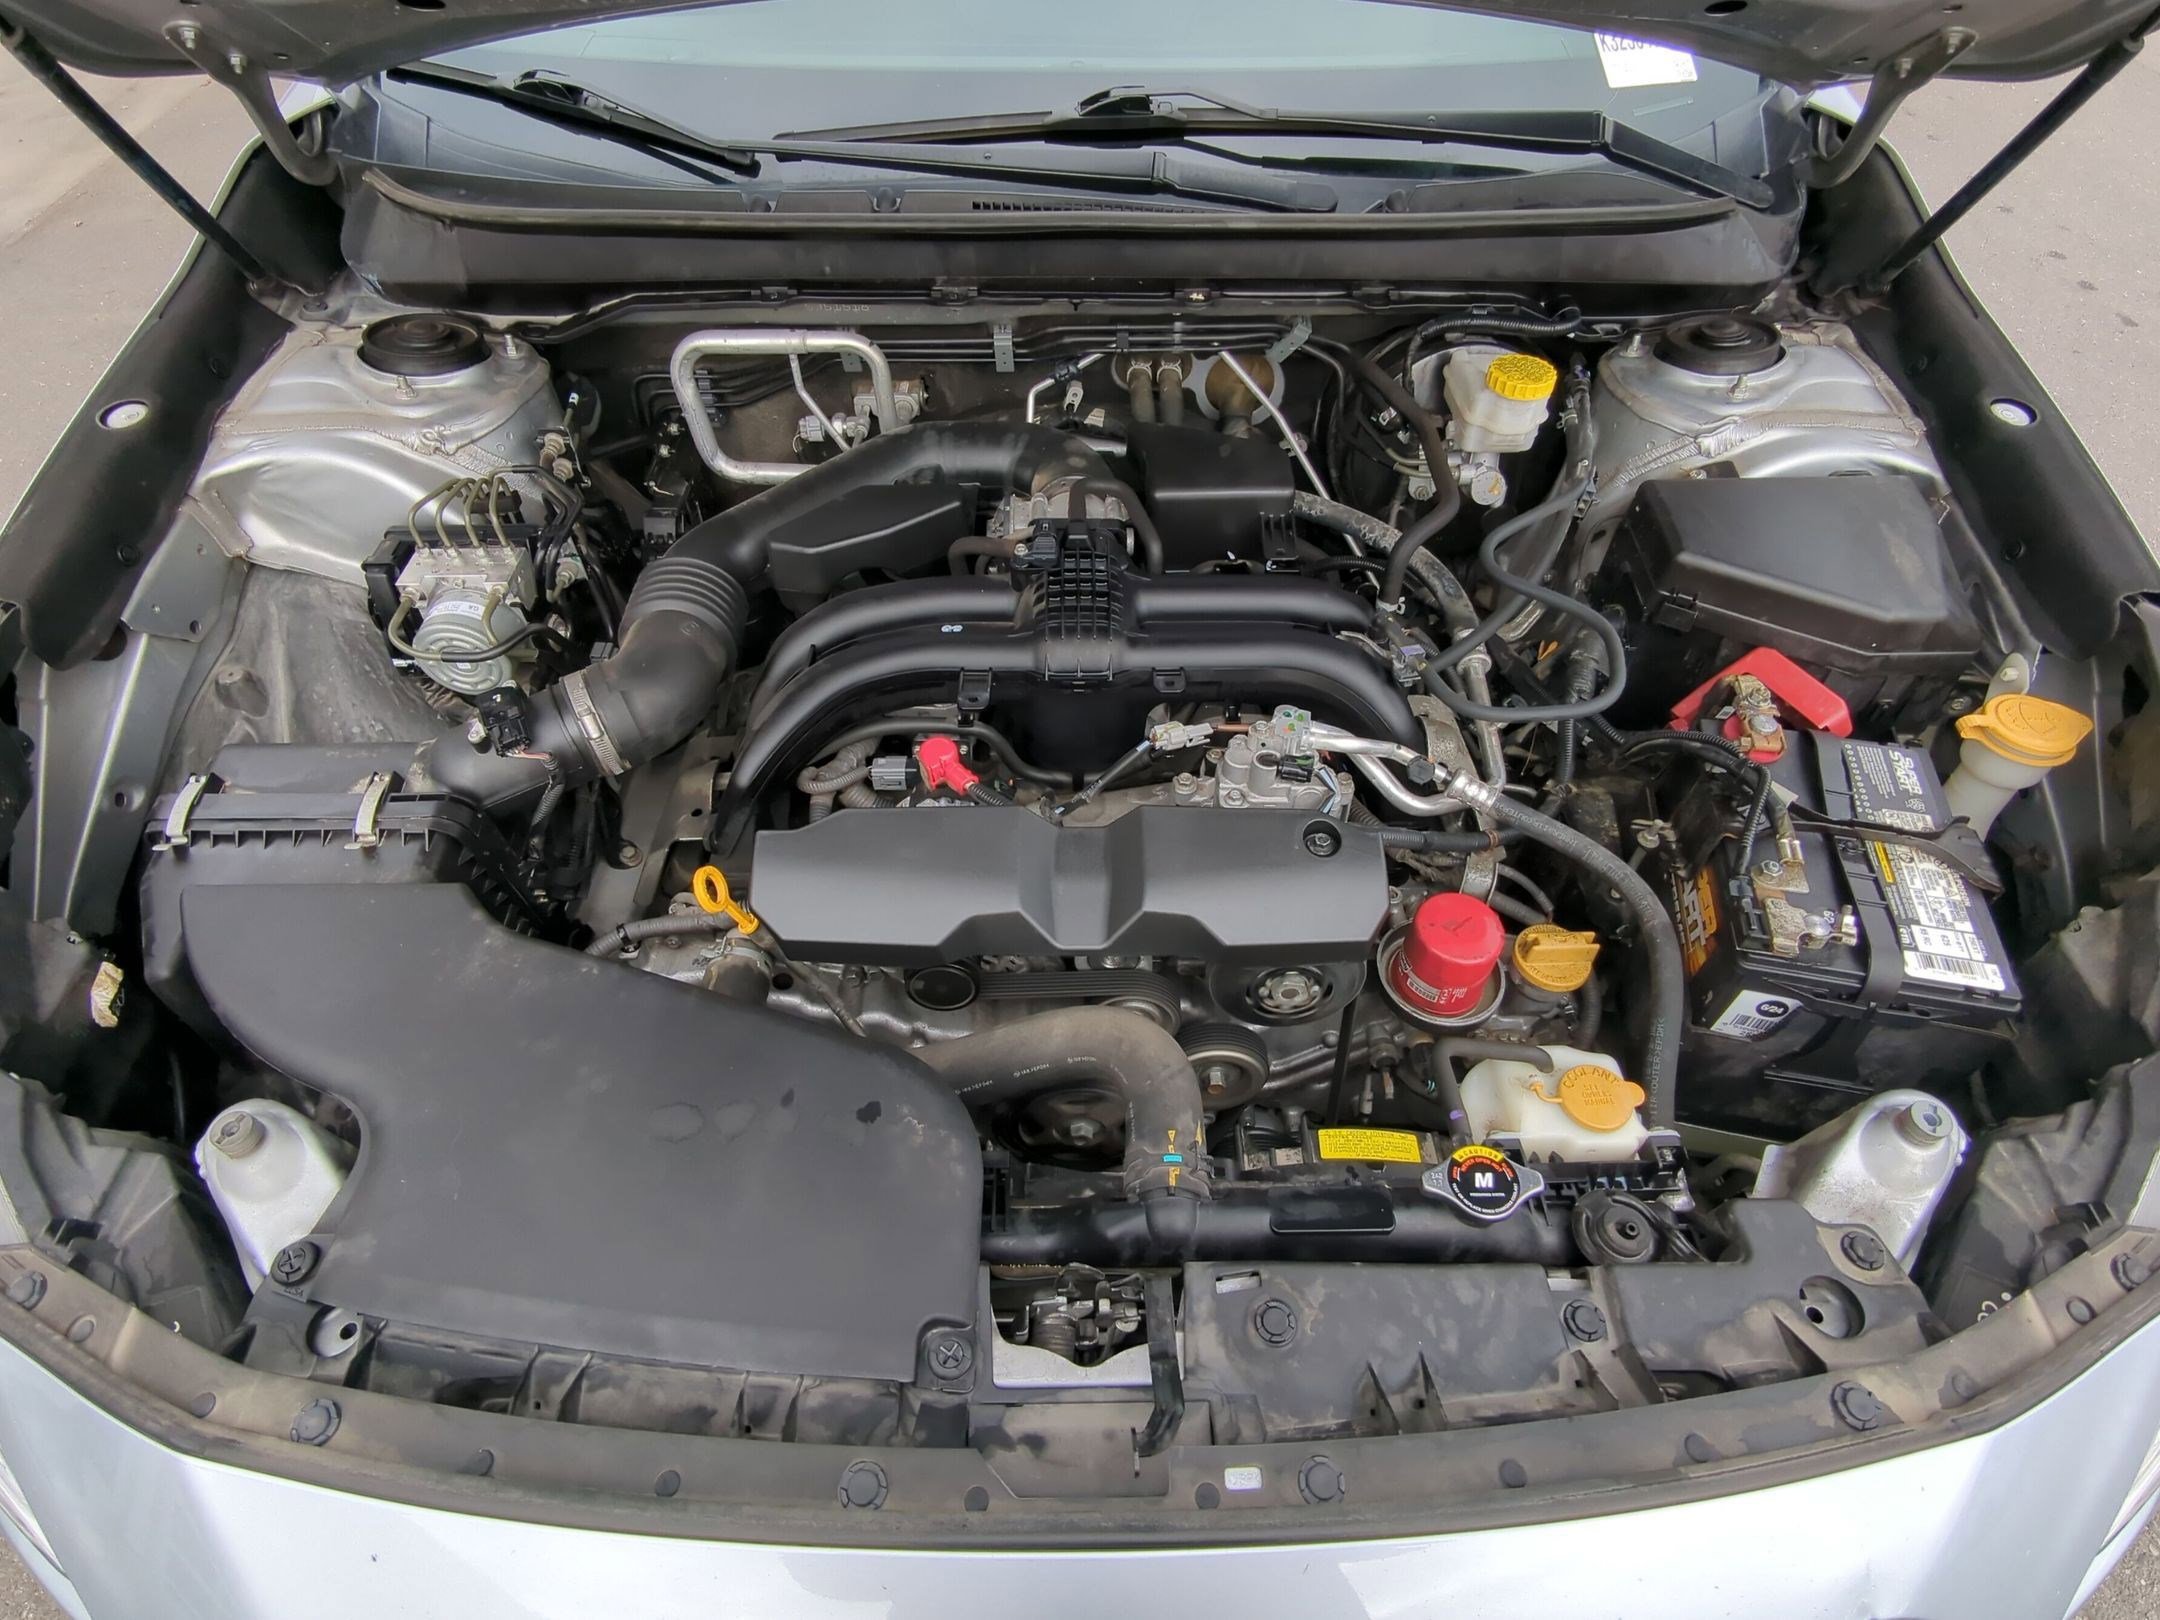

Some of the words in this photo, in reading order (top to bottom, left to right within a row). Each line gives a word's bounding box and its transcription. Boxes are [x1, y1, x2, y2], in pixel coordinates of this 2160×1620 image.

[1888, 749, 1910, 792] START
[1904, 757, 1923, 795] SUPER
[1562, 1066, 1619, 1088] COOLANT
[1463, 1148, 1499, 1159] CAUTION
[1474, 1172, 1493, 1188] M
